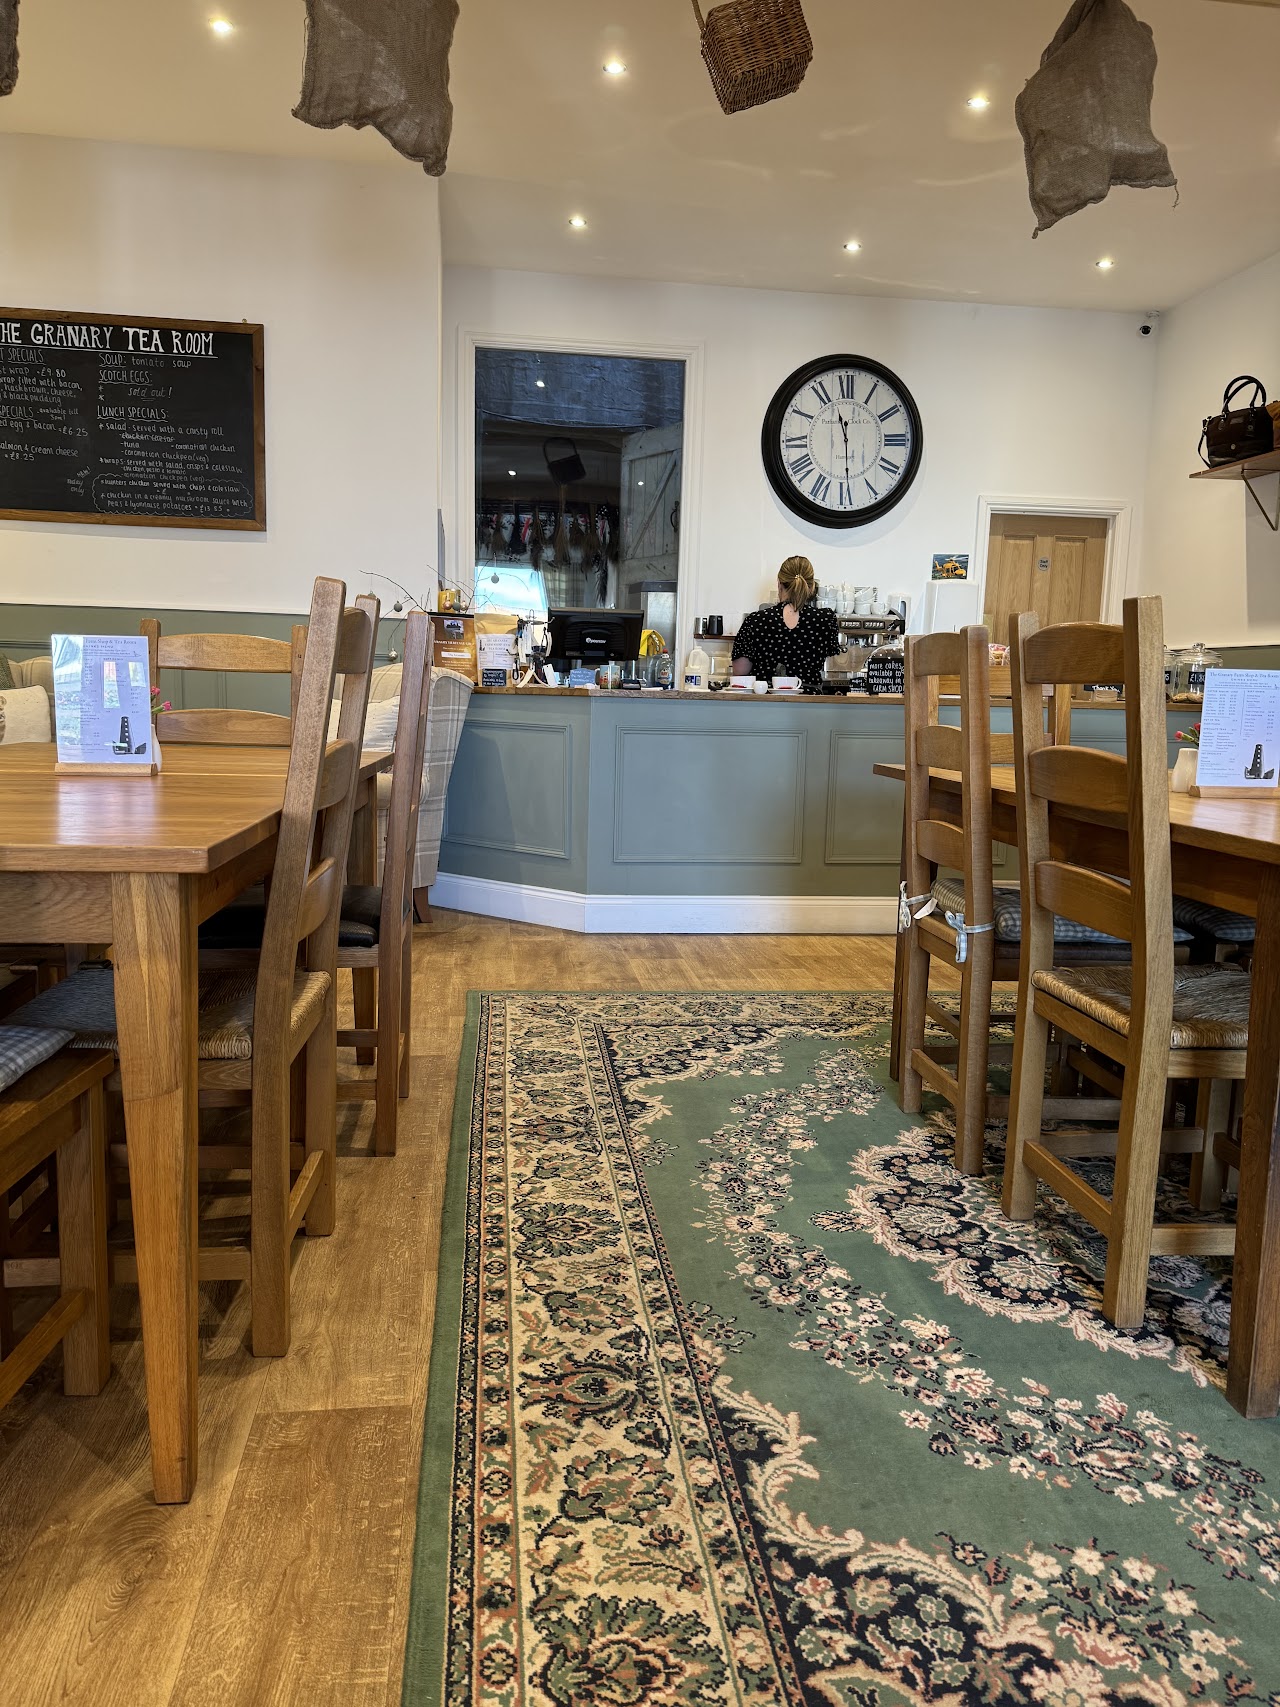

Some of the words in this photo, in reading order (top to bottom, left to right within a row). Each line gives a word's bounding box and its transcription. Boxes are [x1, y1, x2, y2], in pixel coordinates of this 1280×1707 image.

[0, 323, 22, 344] HE
[31, 323, 114, 350] GRANARY
[123, 327, 165, 353] TEA
[171, 331, 214, 356] ROOM
[8, 348, 45, 362] SPECIALS
[100, 353, 127, 366] SOUP:
[132, 356, 165, 368] tomato
[173, 360, 192, 369] soup
[9, 367, 30, 377] wrap
[100, 370, 127, 382] SCOTCH
[18, 376, 37, 386] filled
[39, 378, 56, 388] with
[128, 387, 148, 398] sold
[30, 393, 62, 407] pudding
[97, 405, 125, 418] LUNCH
[10, 421, 24, 433] egg
[33, 419, 57, 430] bacon
[847, 418, 861, 426] Clock
[132, 424, 156, 433] served
[159, 425, 175, 434] with
[178, 427, 184, 435] a
[186, 427, 208, 439] crusty
[211, 426, 225, 436] roll
[0, 440, 24, 452] almon
[55, 445, 79, 457] cheese
[210, 444, 236, 453] chicken
[231, 499, 249, 507] with
[869, 669, 893, 677] available
